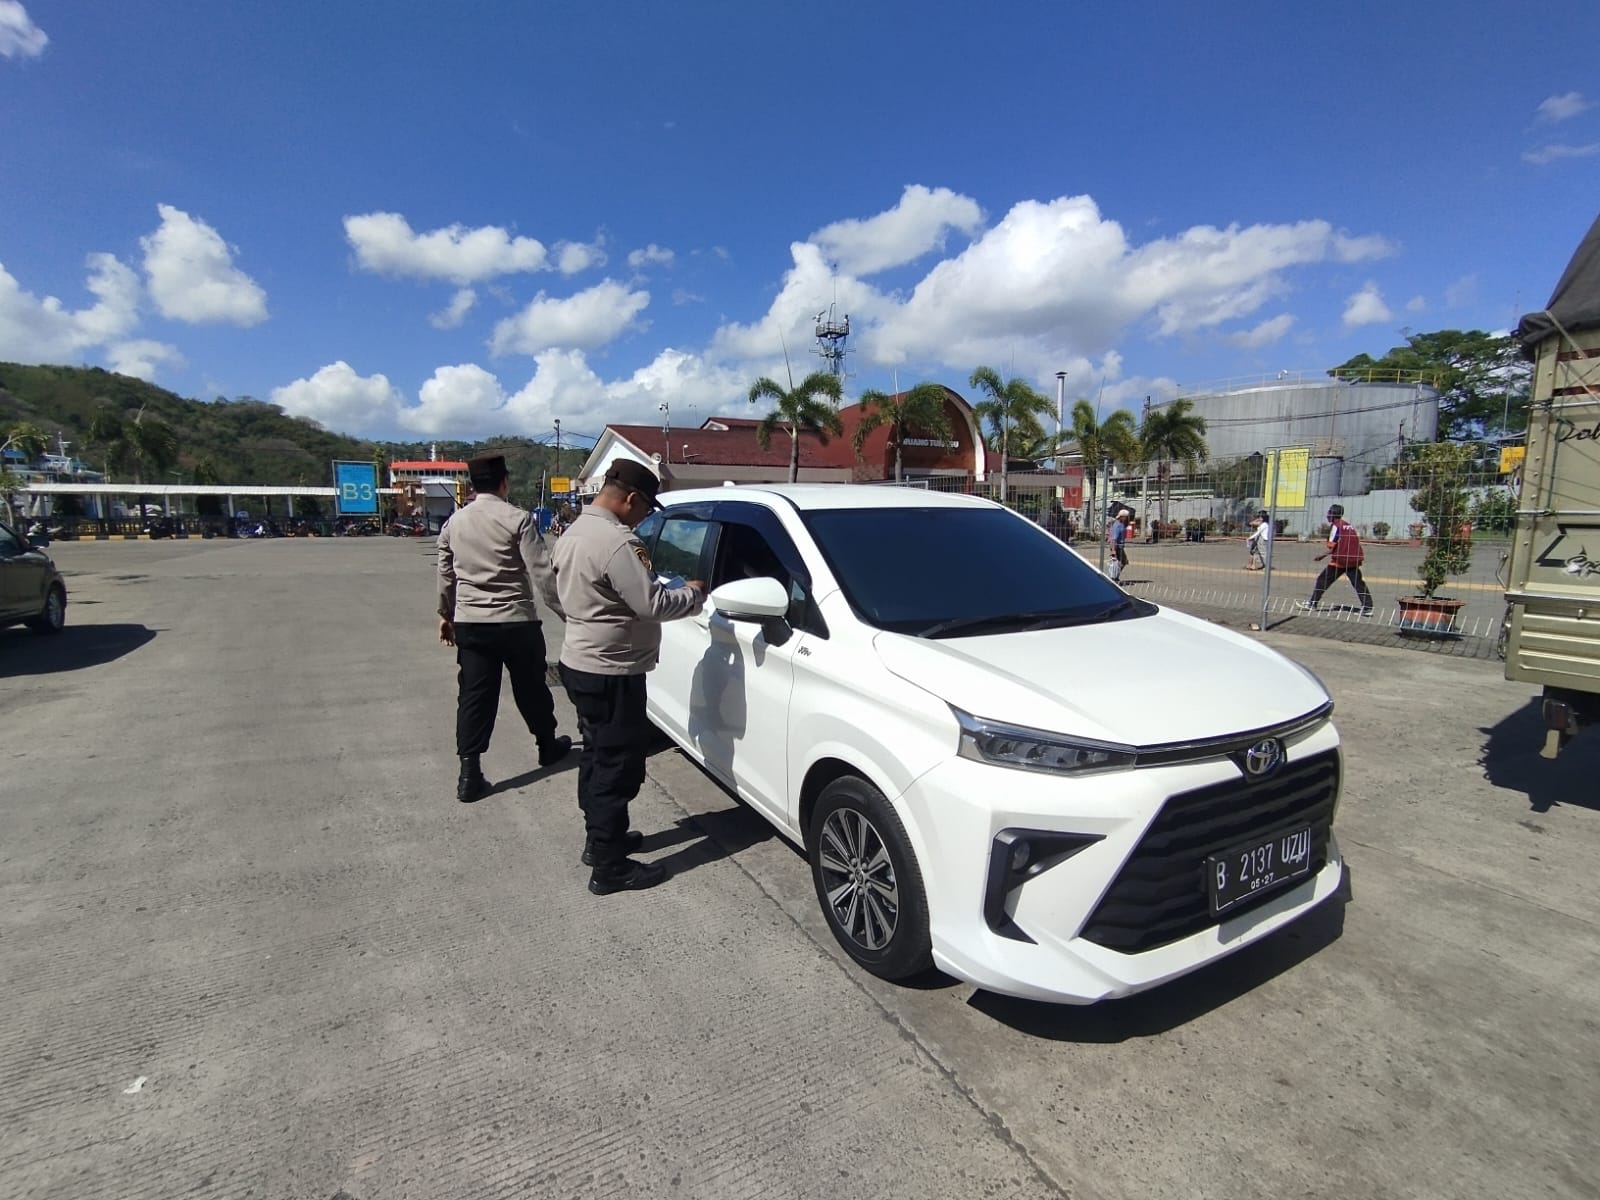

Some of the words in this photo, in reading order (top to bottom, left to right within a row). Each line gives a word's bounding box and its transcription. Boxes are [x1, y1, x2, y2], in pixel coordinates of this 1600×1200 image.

[342, 483, 373, 501] B3
[1216, 861, 1226, 890] B
[1240, 843, 1274, 882] 2137
[1281, 831, 1308, 864] UZU
